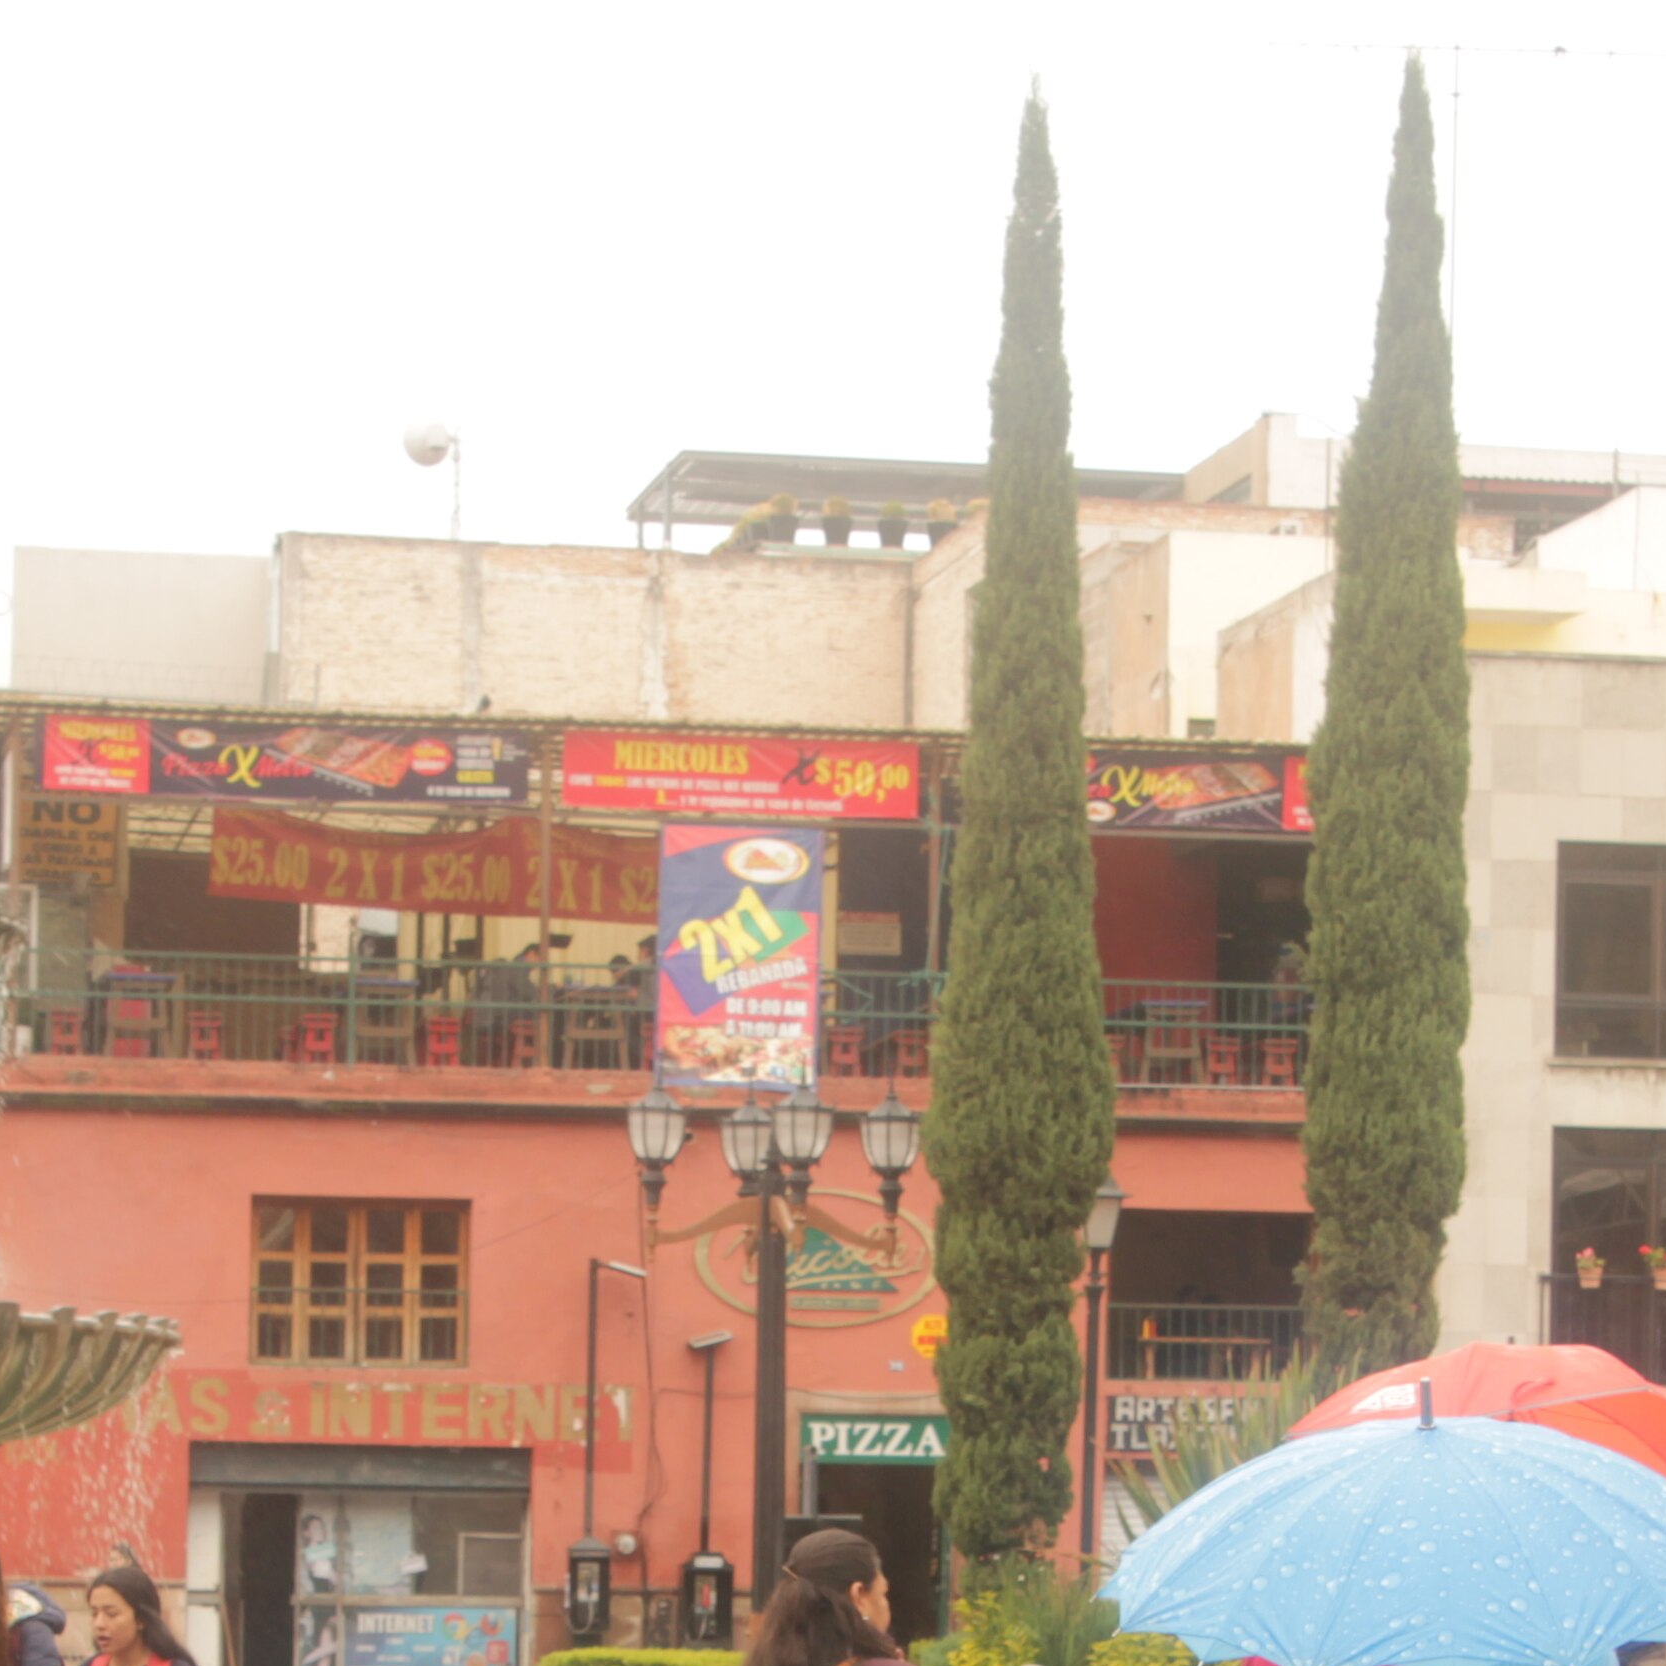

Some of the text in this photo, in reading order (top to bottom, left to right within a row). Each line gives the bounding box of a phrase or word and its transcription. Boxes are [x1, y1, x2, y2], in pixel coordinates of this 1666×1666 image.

[218, 743, 262, 789] X
[614, 740, 750, 775] MIERCOLES
[1100, 765, 1141, 807] X
[32, 802, 101, 825] NO
[211, 834, 310, 890] $25.00
[325, 847, 349, 898] 2
[358, 849, 380, 899] X
[390, 851, 404, 902] 1
[421, 854, 511, 903] $25.00
[557, 858, 578, 911] X
[589, 862, 603, 913] 1
[715, 956, 809, 995] REBANADA
[725, 997, 745, 1015] DE
[783, 1000, 808, 1018] AM
[777, 1022, 803, 1039] AM
[309, 1380, 632, 1443] INTERNET
[807, 1421, 947, 1458] PIZZA
[357, 1612, 435, 1634] INTERNET
